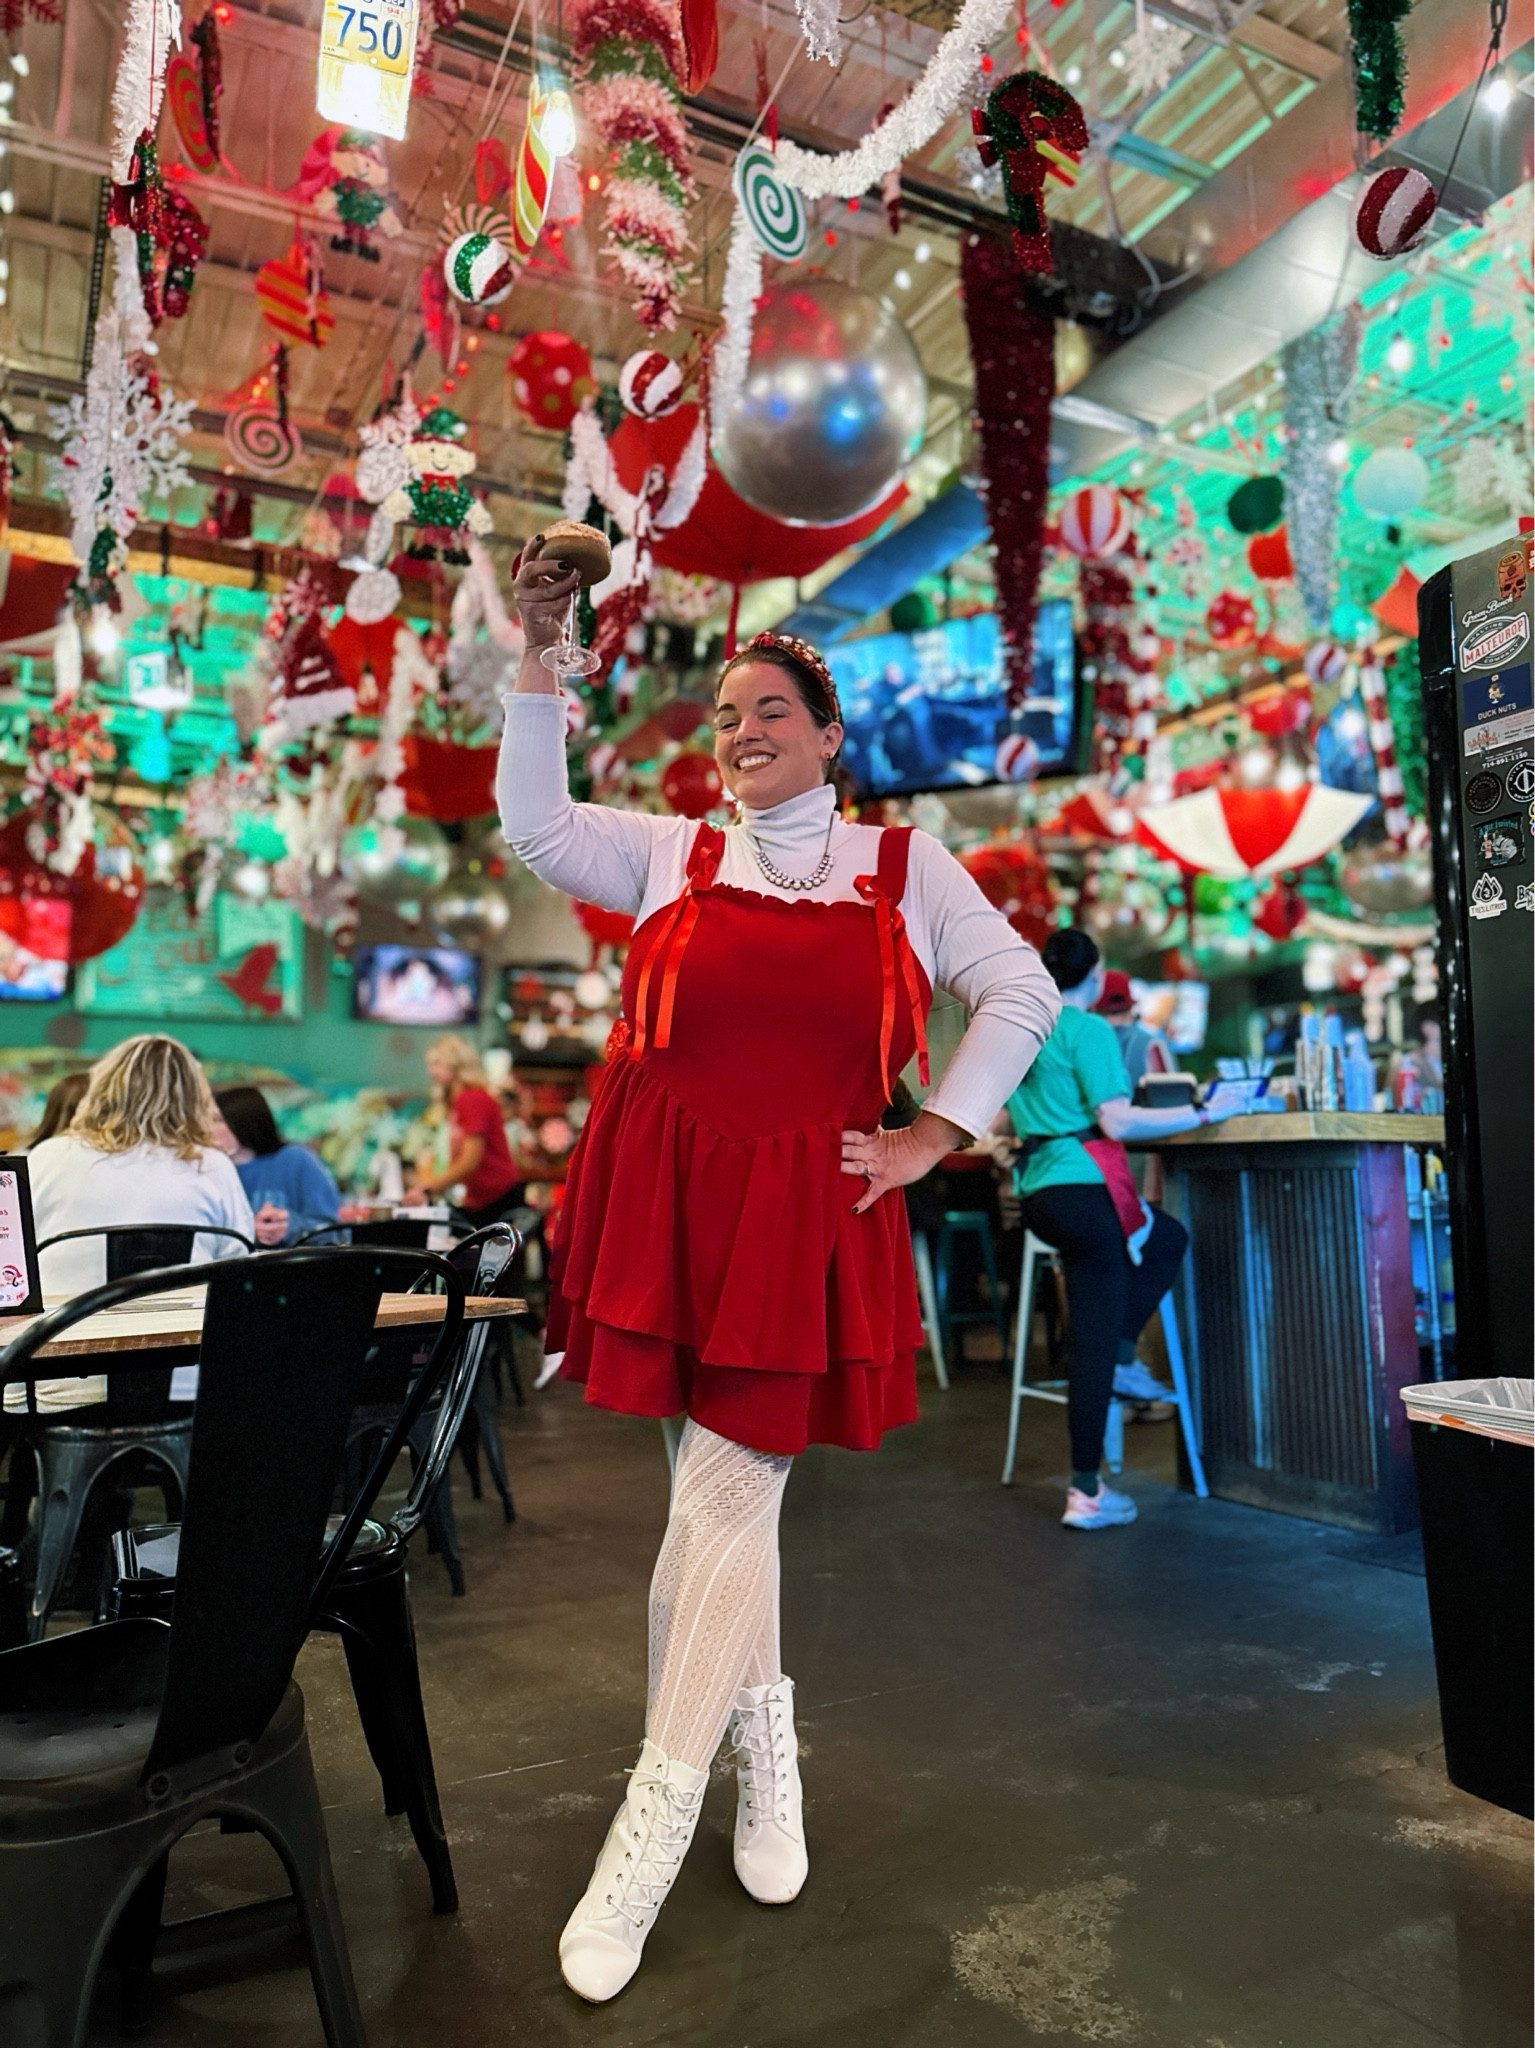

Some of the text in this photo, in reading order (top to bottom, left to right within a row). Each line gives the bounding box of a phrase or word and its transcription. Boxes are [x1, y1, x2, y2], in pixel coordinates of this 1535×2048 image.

[386, 6, 400, 15] 94
[338, 4, 402, 60] 750
[1465, 620, 1524, 665] MALTEUROP
[1469, 622, 1503, 643] MALTING
[1483, 643, 1519, 664] COMPANY
[1478, 703, 1517, 721] DUCK NUTS
